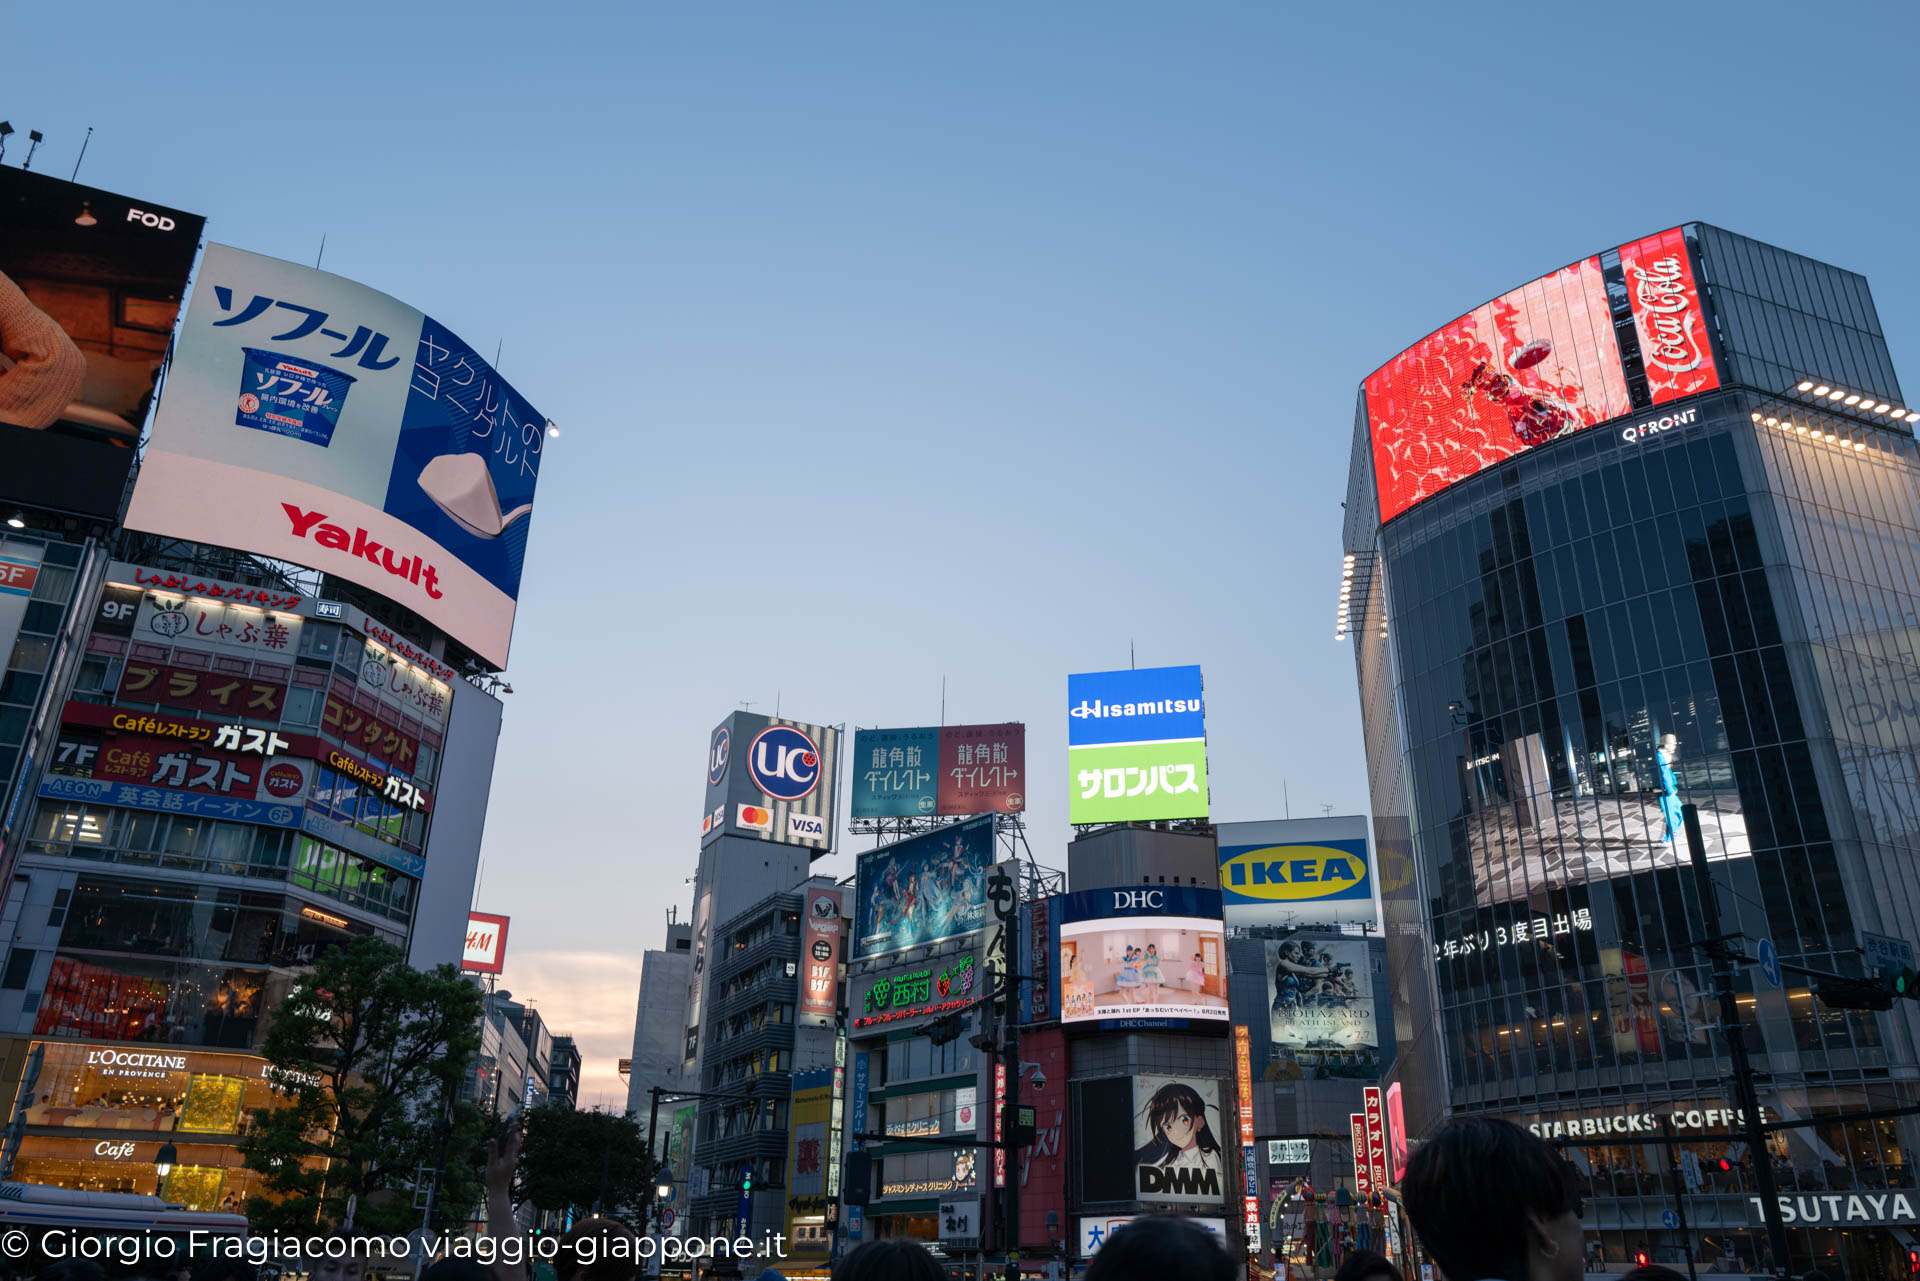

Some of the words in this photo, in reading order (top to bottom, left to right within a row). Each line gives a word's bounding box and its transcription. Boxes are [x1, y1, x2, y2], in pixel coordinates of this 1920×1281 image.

[127, 207, 175, 232] FOD
[212, 285, 400, 371] ソフール
[256, 372, 333, 406] ソフール
[420, 334, 542, 455] ヤクルトの
[410, 365, 537, 478] ヨーグルト
[1622, 409, 1696, 442] QFRONT
[281, 503, 443, 600] Yakult
[135, 568, 301, 610] しゃぶしゃぶバイキング
[102, 601, 135, 620] 9F
[318, 604, 340, 616] 寿司
[195, 611, 289, 649] しゃぶ葉
[364, 617, 456, 681] しゃぶしゃぶバイキング
[124, 665, 281, 713] プライス
[390, 668, 445, 717] しゃぶ葉
[1071, 699, 1200, 719] Hisamitsu
[213, 724, 289, 756] ガスト
[323, 698, 414, 762] コンタクト
[57, 741, 99, 765] 7F
[106, 748, 151, 766] Café
[711, 739, 728, 773] UC
[757, 741, 814, 783] UC
[872, 745, 922, 769] 龍角散
[957, 742, 1009, 765] 龍角散
[104, 764, 148, 778] レストラン
[151, 752, 251, 793] ガスト
[864, 769, 931, 792] ダイレクト
[950, 766, 1018, 789] ダイレクト
[1077, 763, 1199, 799] サロンパス
[51, 777, 102, 798] AEON
[268, 777, 299, 790] ガスト
[383, 774, 426, 810] ガスト
[272, 809, 290, 823] 6F
[792, 819, 822, 834] VISA
[1230, 858, 1356, 885] IKEA
[1113, 889, 1163, 910] DHC
[465, 931, 492, 952] H&M
[893, 978, 930, 1007] 西村
[1120, 1019, 1138, 1027] DHC
[1278, 1008, 1370, 1018] BIOHAZARD
[1354, 1030, 1370, 1040] 7.7
[87, 1049, 187, 1070] L'OCCITANE
[102, 1068, 114, 1076] EN
[118, 1069, 167, 1079] PROVENCE
[1367, 1096, 1384, 1158] カラオケ
[1529, 1113, 1657, 1139] STARBUCKS
[94, 1142, 134, 1160] Café
[1270, 1153, 1309, 1162] クリニック
[1280, 1142, 1308, 1151] れいわ
[1140, 1166, 1220, 1196] DMM
[1246, 1201, 1258, 1223] 焼肉
[1749, 1193, 1917, 1223] TSUTAYA
